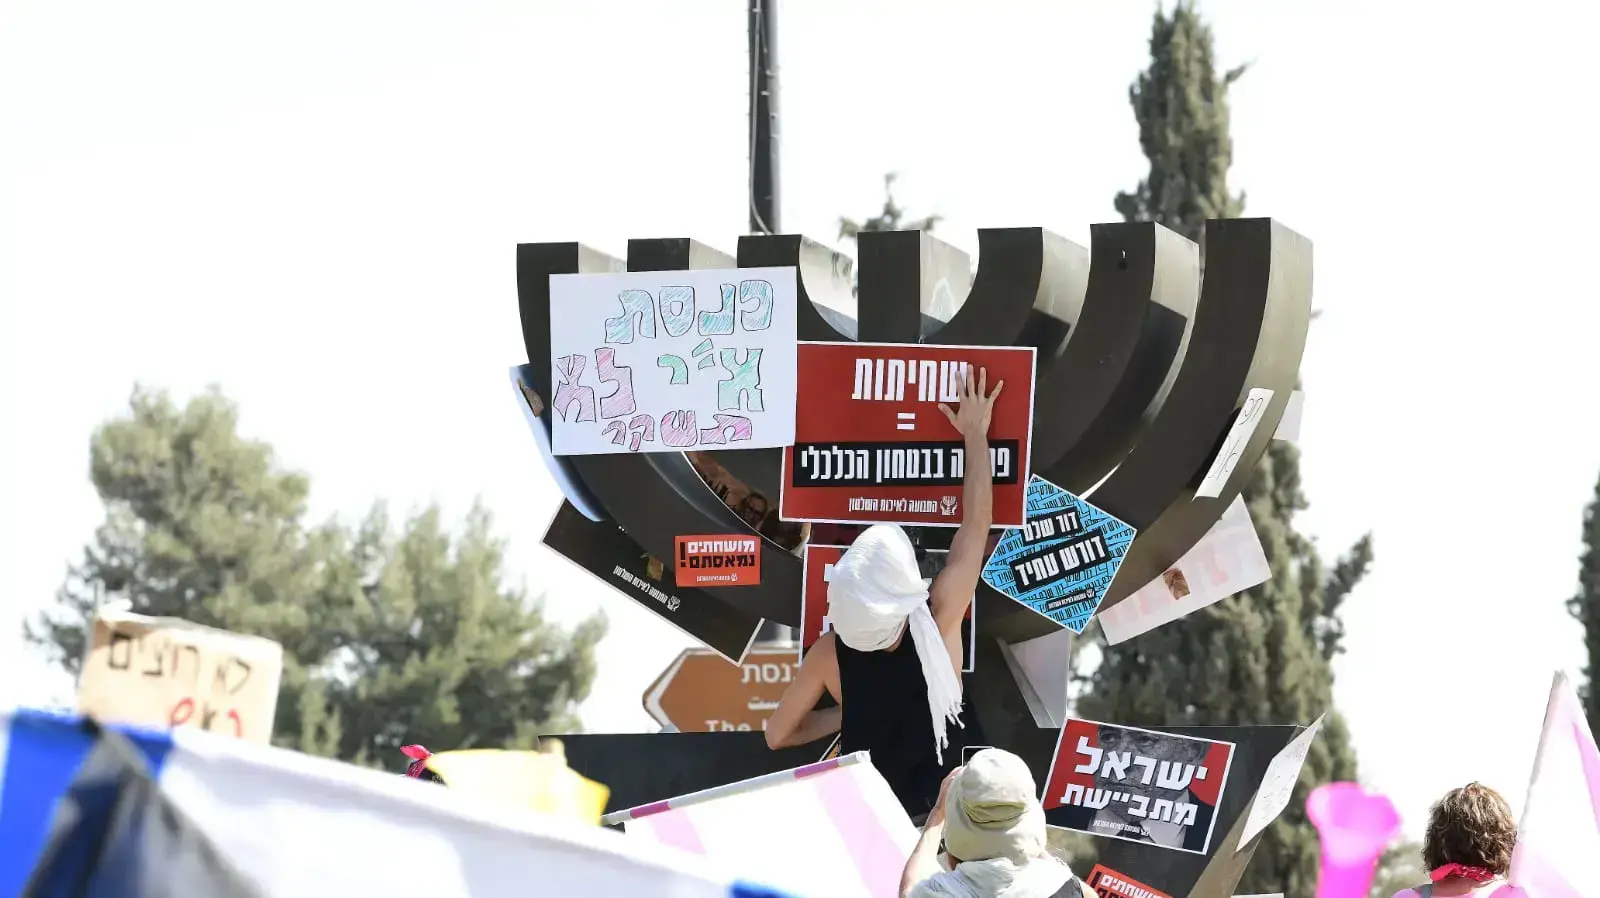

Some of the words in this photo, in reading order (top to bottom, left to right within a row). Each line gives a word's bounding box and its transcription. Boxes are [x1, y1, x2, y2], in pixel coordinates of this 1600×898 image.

[605, 279, 774, 344] כנסת
[553, 347, 637, 423] לא
[851, 358, 968, 403] שחיתות
[602, 409, 752, 453] תשקר
[801, 445, 870, 480] הכלכלי
[876, 448, 945, 483] בבטחון
[848, 496, 879, 512] השלטון
[879, 498, 908, 512] לאיכות
[1022, 517, 1055, 543] שלם
[1055, 511, 1079, 534] דור
[687, 540, 755, 554] מושחתים
[688, 554, 755, 569] נמאסתם
[1058, 535, 1106, 571] דורש
[1014, 552, 1060, 586] עתיד
[1074, 736, 1209, 791] ישראל
[1060, 784, 1199, 826] מתביישת
